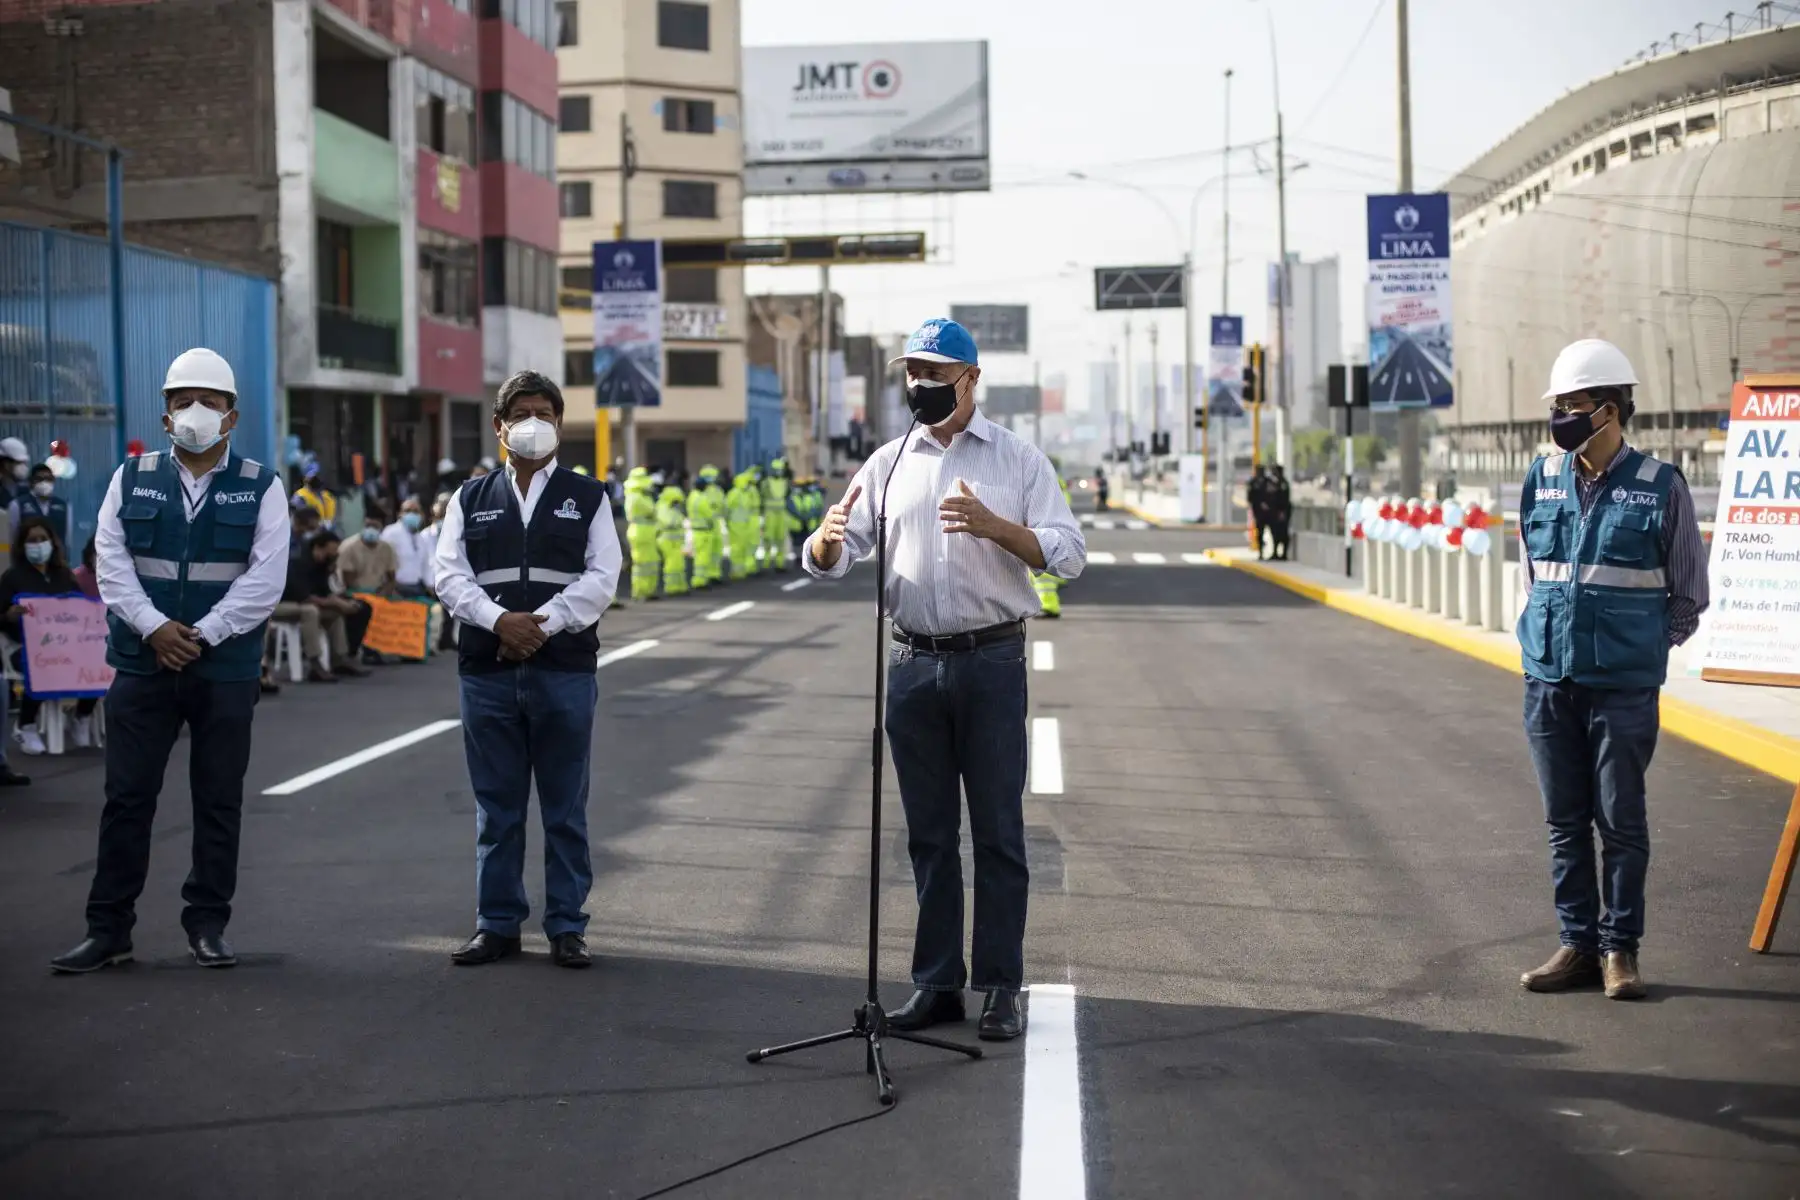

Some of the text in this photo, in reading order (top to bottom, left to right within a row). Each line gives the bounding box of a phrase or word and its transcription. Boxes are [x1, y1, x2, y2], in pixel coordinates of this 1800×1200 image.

[793, 61, 860, 92] JMT
[1380, 240, 1435, 257] LIMA
[911, 341, 938, 351] LIMA
[1741, 393, 1800, 417] AMP
[1738, 429, 1789, 458] AV.
[1733, 470, 1774, 499] LA
[132, 487, 158, 499] EMAPE
[230, 494, 256, 503] LIMA
[1630, 494, 1657, 506] LIMA
[476, 514, 498, 522] ALCALDE
[1733, 507, 1800, 525] de dos a
[1726, 532, 1773, 544] TRAMO:
[1722, 548, 1734, 562] Jr.
[1738, 549, 1761, 560] Von
[1732, 600, 1754, 611] Más
[1757, 600, 1771, 611] de
